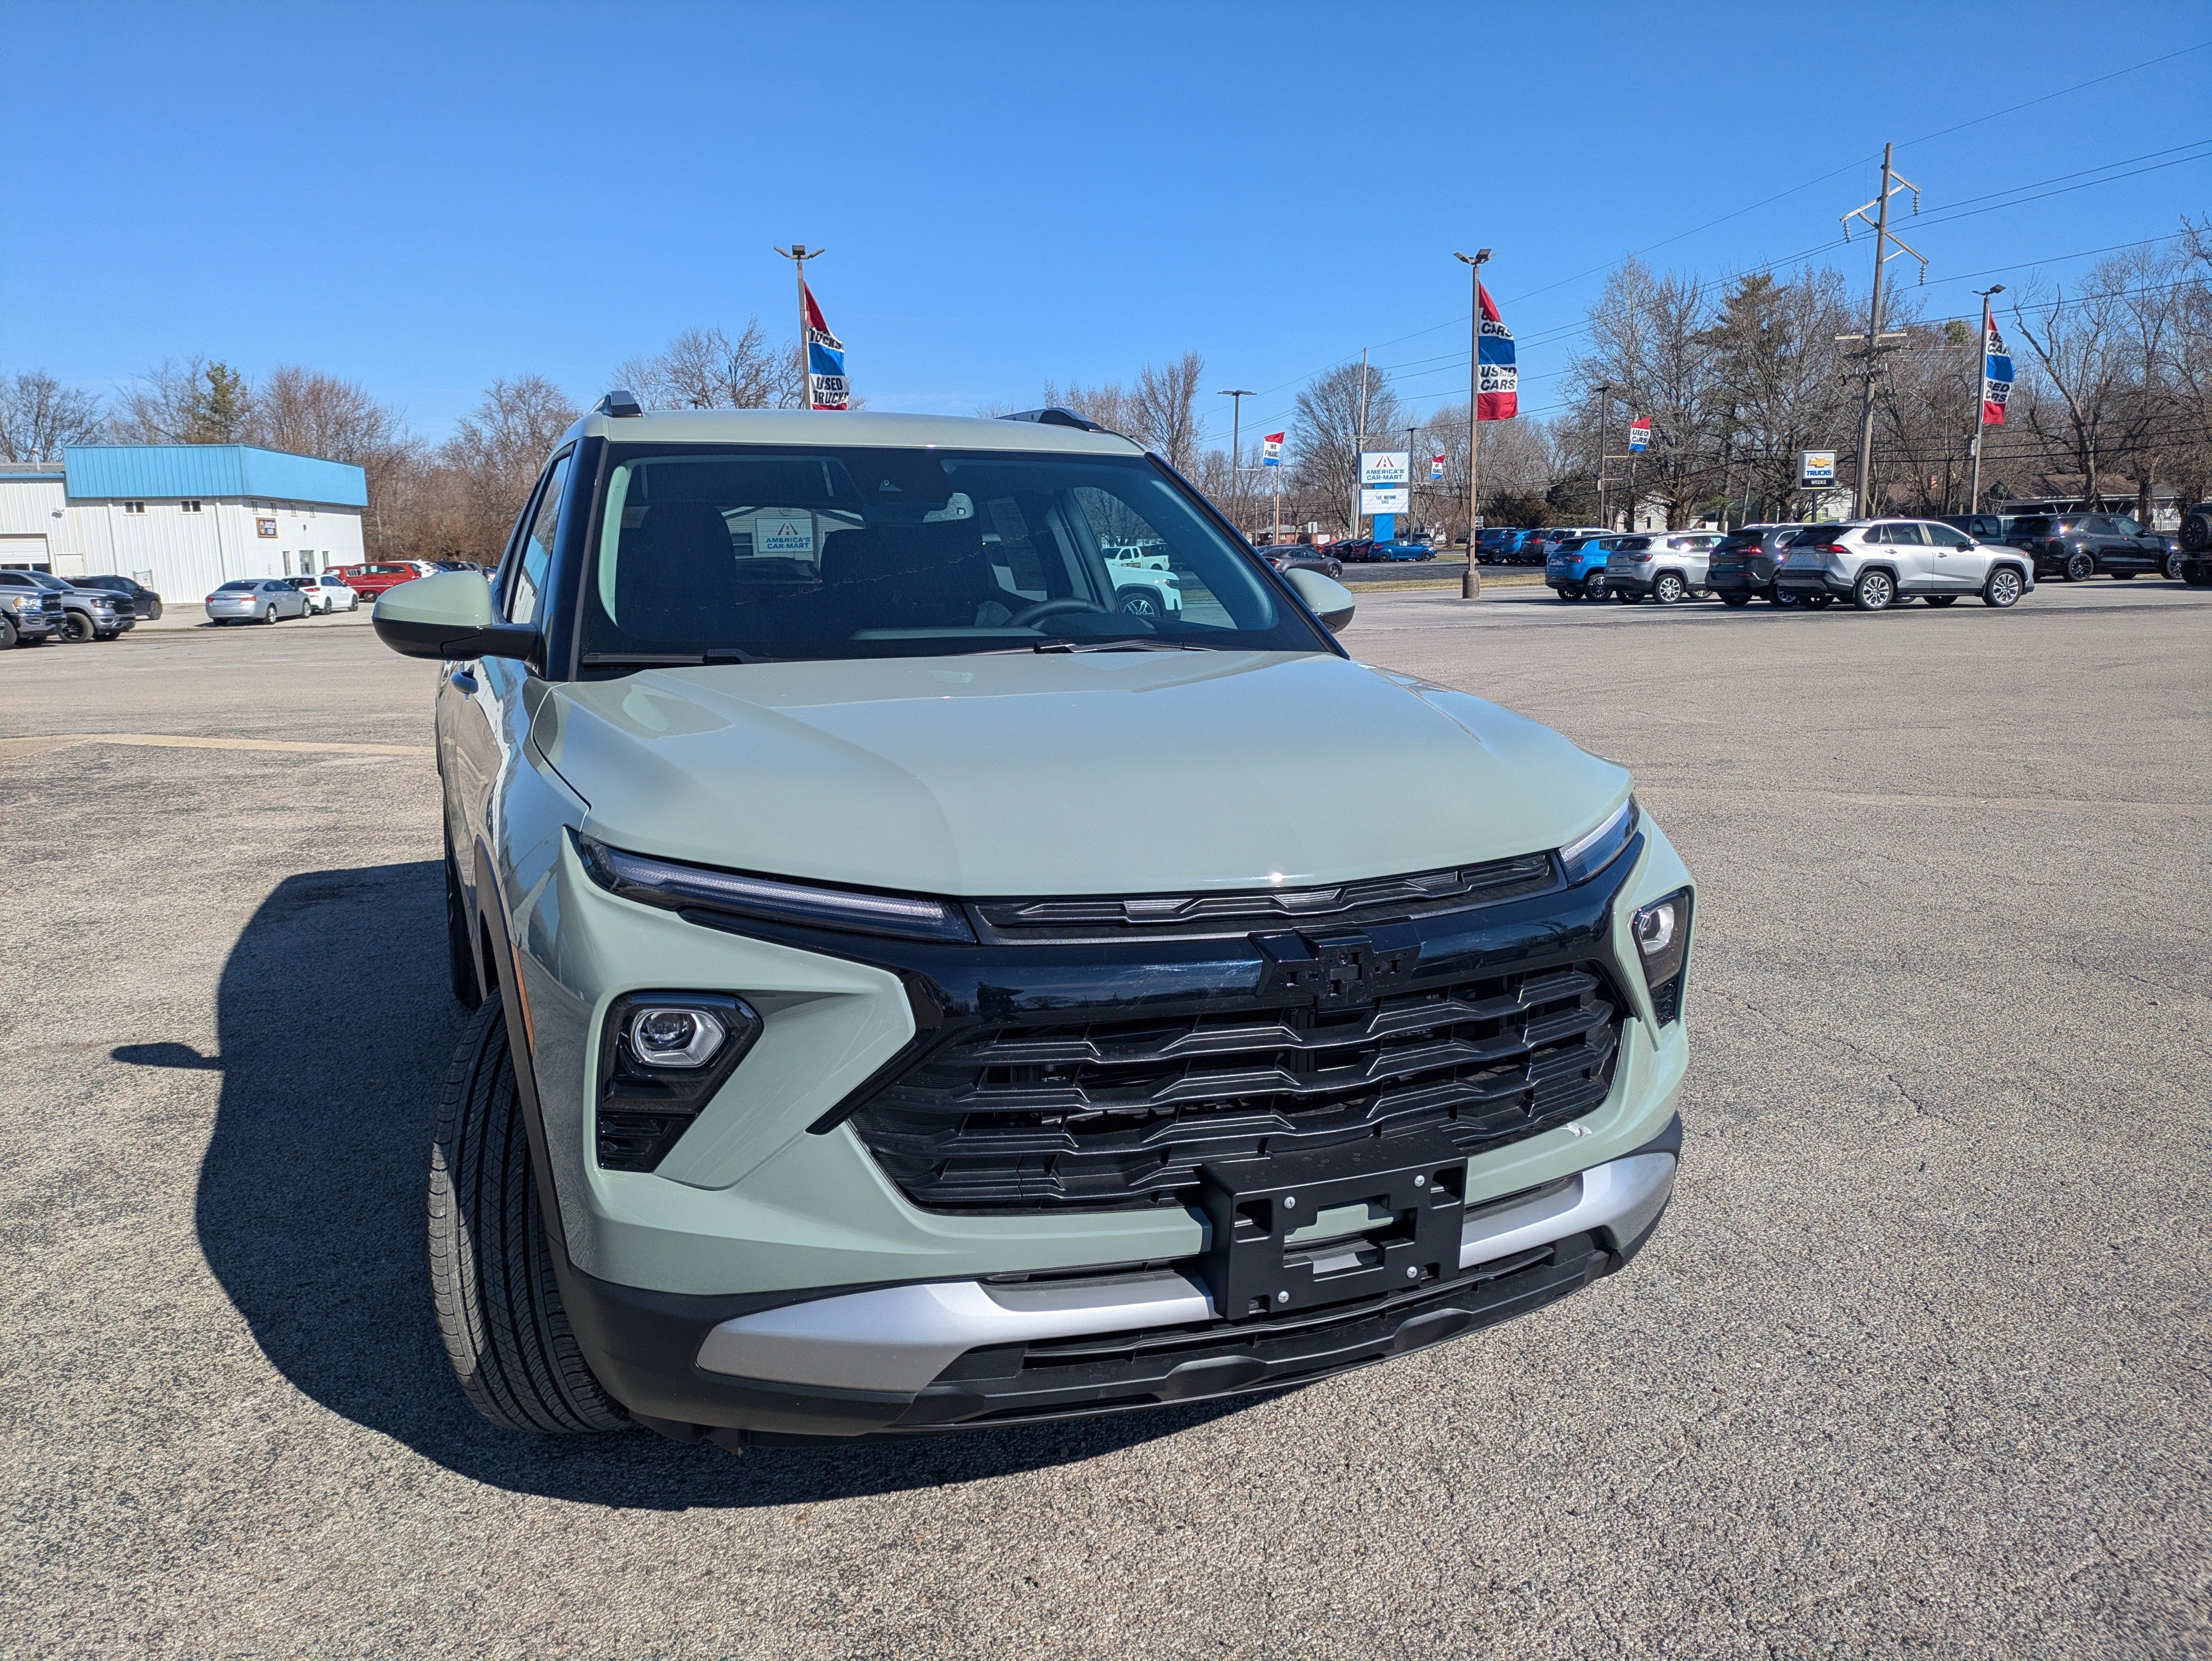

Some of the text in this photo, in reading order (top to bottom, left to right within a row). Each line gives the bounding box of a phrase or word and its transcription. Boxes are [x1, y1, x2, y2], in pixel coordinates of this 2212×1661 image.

[816, 376, 843, 390] USED
[1481, 379, 1516, 391] CARS
[813, 390, 849, 404] TRUCKS
